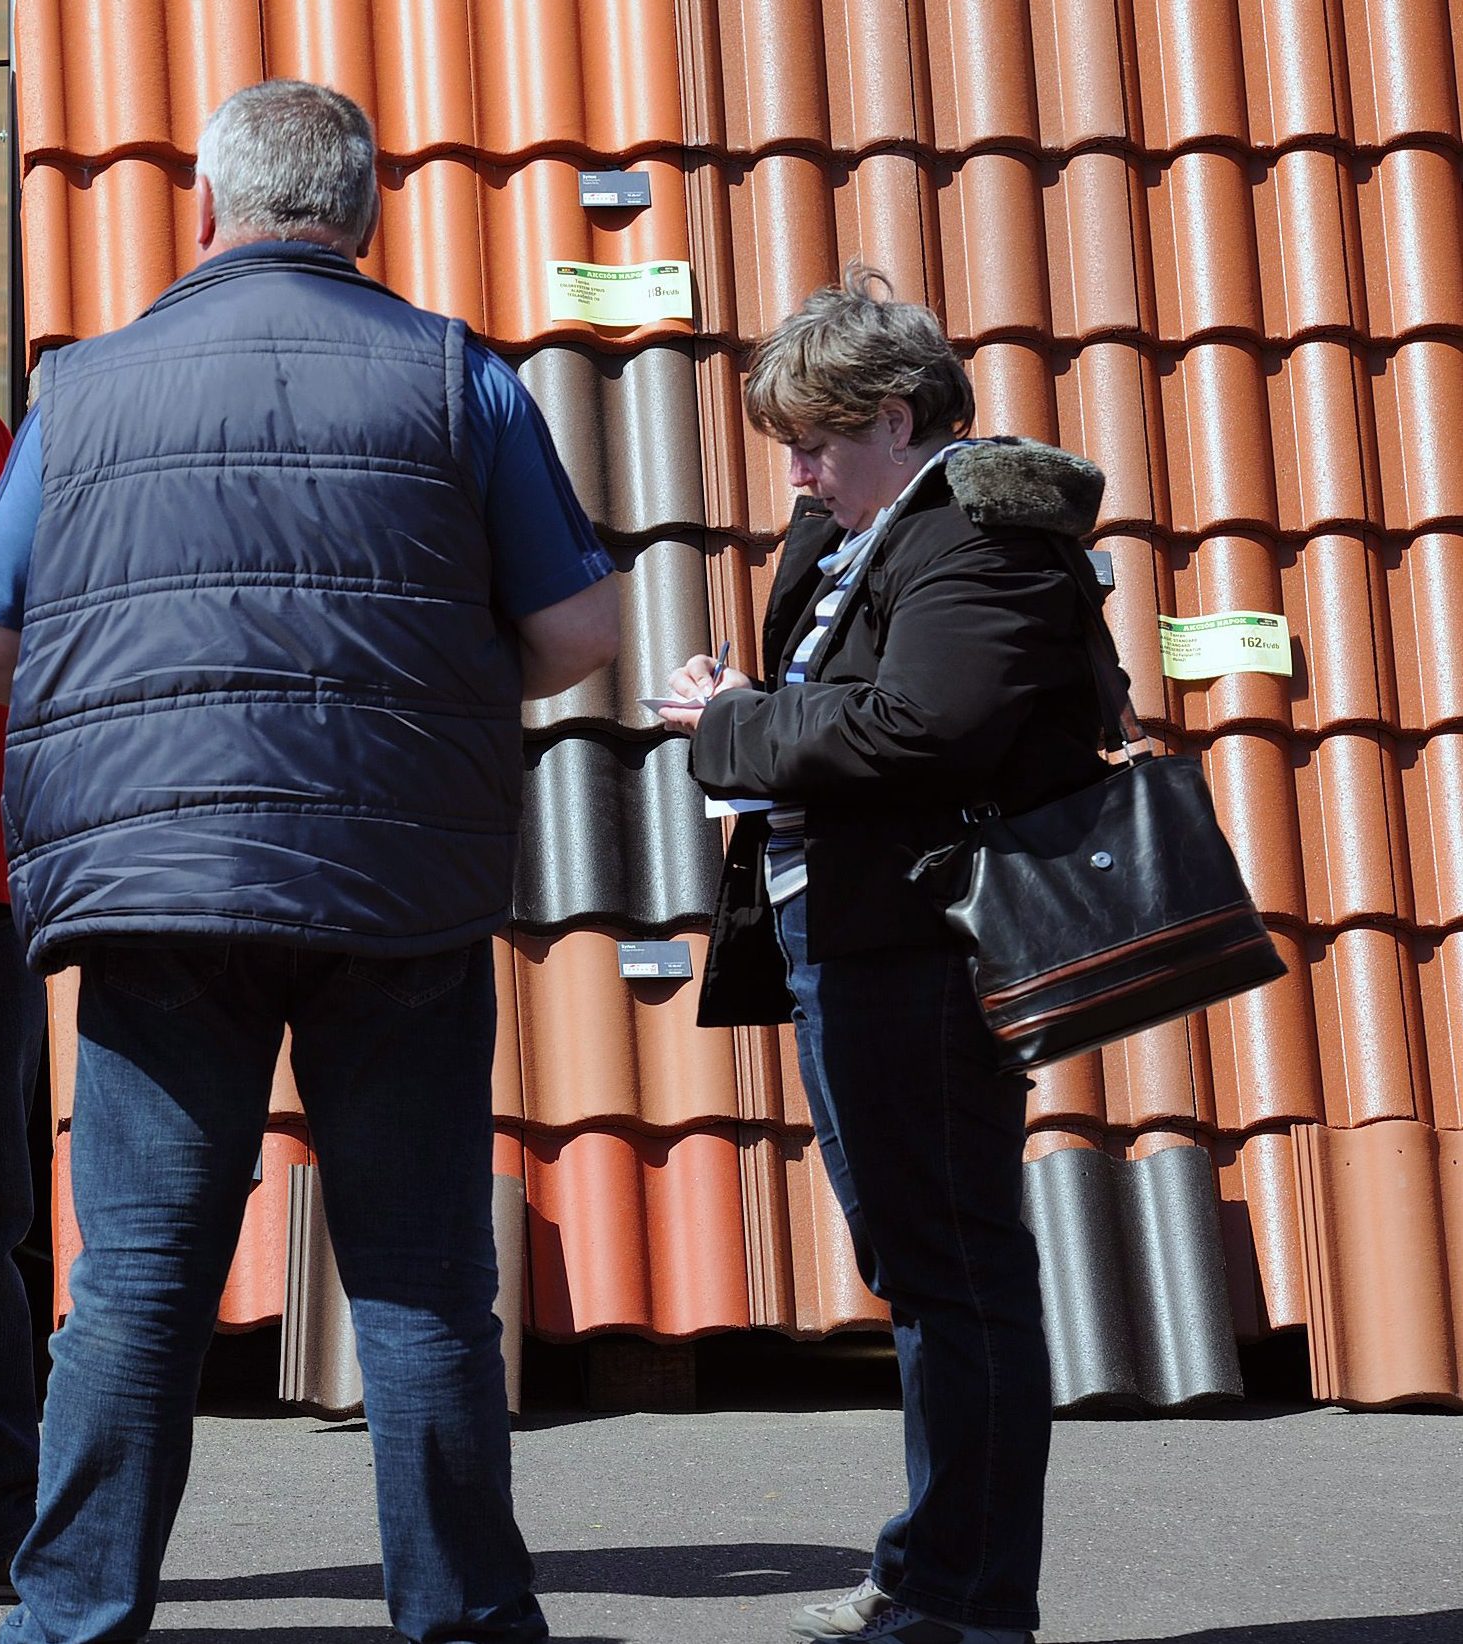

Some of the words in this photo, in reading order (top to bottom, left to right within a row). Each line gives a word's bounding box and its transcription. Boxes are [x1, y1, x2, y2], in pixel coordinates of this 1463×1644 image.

[586, 271, 617, 279] AKCIÓS
[1182, 622, 1216, 632] AKCIÓS
[1216, 618, 1248, 626] NAPOK
